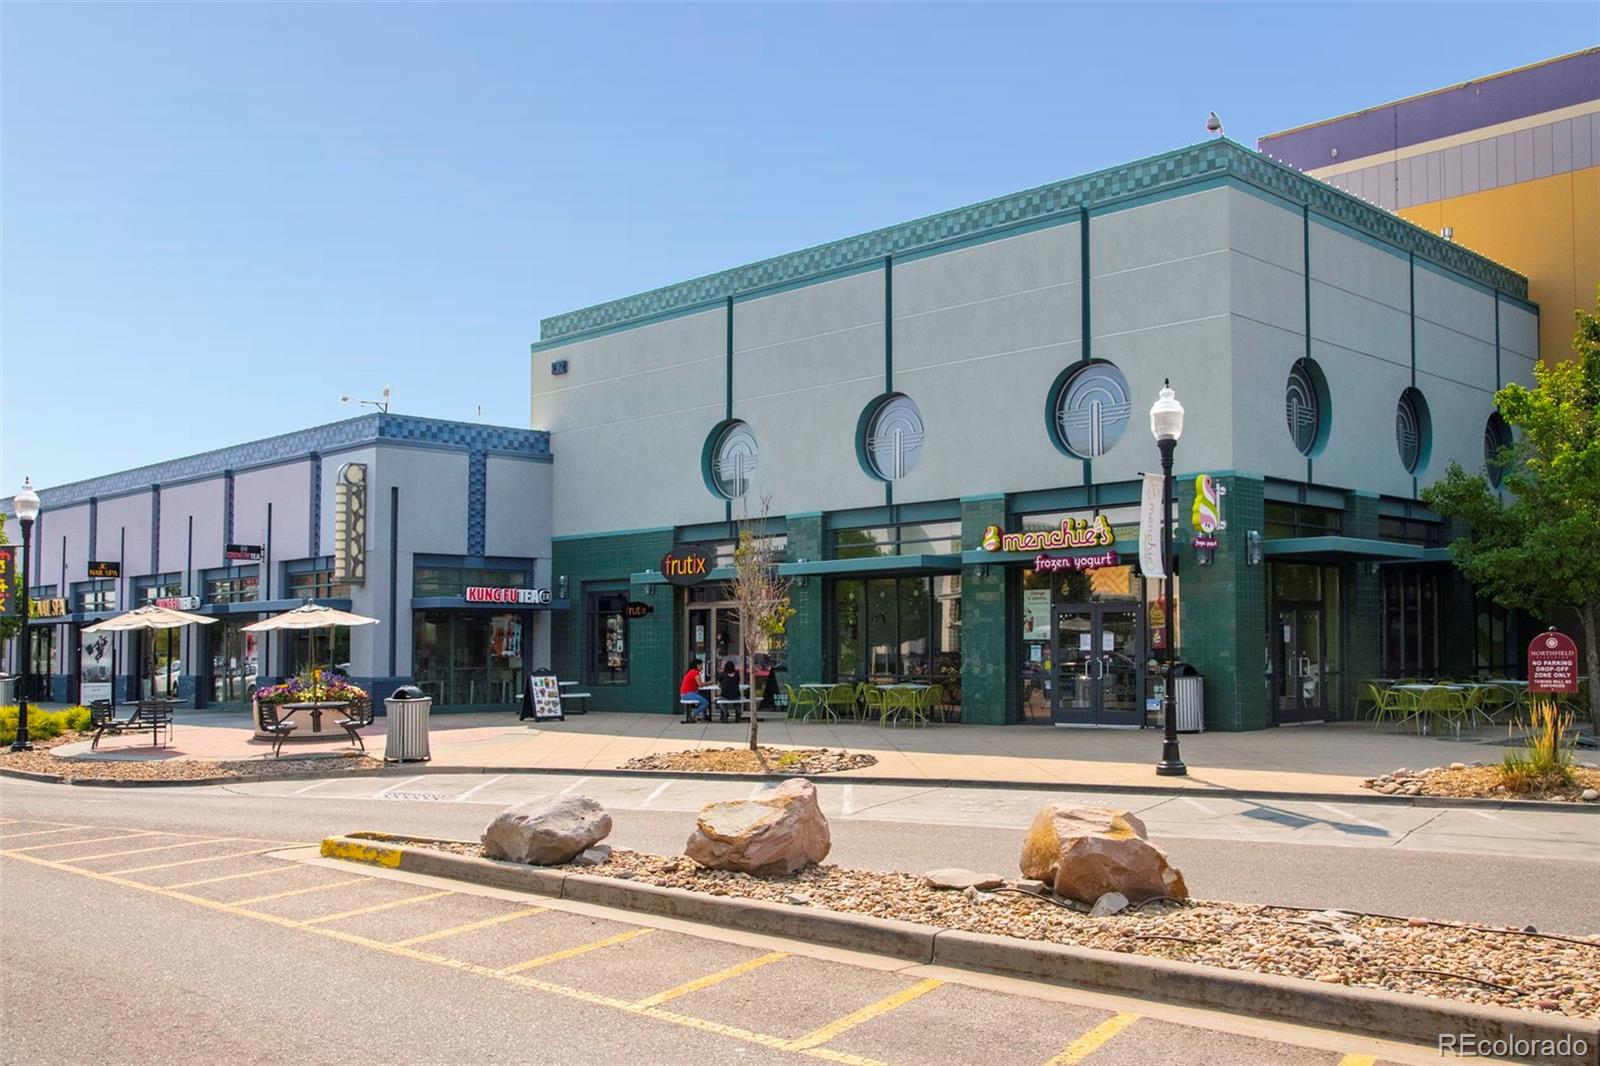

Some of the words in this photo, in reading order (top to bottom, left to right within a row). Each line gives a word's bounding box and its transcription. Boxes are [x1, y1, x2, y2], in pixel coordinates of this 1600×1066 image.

[1003, 516, 1112, 551] menchie's
[664, 554, 706, 576] frutix
[1034, 555, 1070, 571] frozen
[1074, 552, 1112, 568] yogurt
[466, 587, 501, 603] KUNG
[501, 588, 517, 603] FU
[517, 589, 539, 604] TEA
[51, 599, 66, 616] SPA
